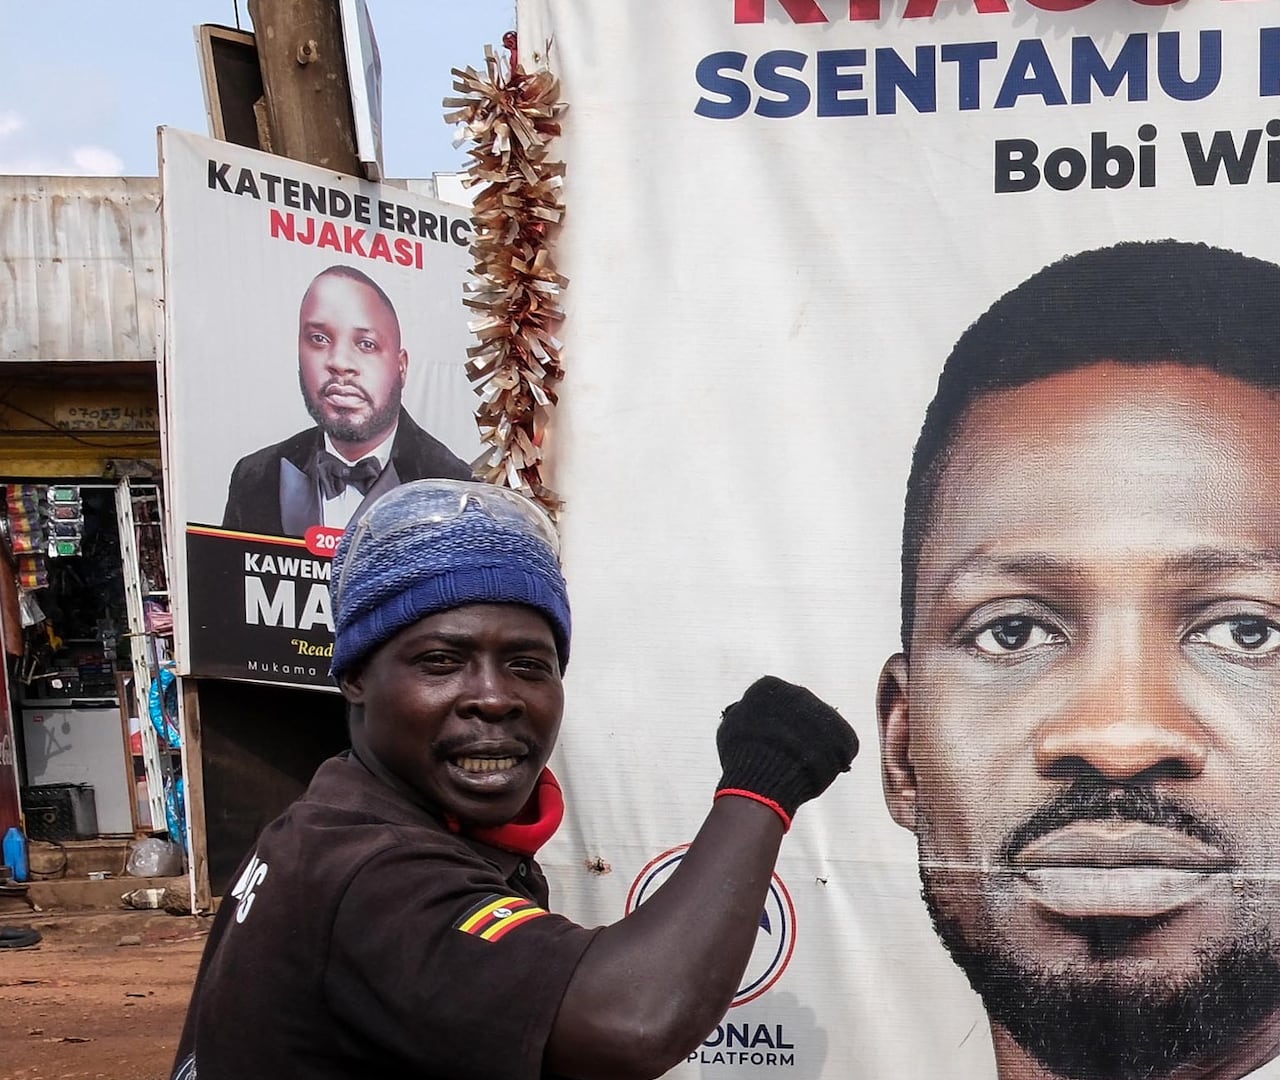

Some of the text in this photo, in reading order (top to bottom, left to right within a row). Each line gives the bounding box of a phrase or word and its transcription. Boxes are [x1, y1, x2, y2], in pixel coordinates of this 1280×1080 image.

[693, 30, 1222, 119] SSENTAMU
[994, 124, 1157, 193] Bobi
[208, 160, 371, 225] KATENDE
[270, 209, 424, 270] NJAKASI
[247, 660, 317, 676] Mukama
[687, 1051, 795, 1066] PLATFORM
